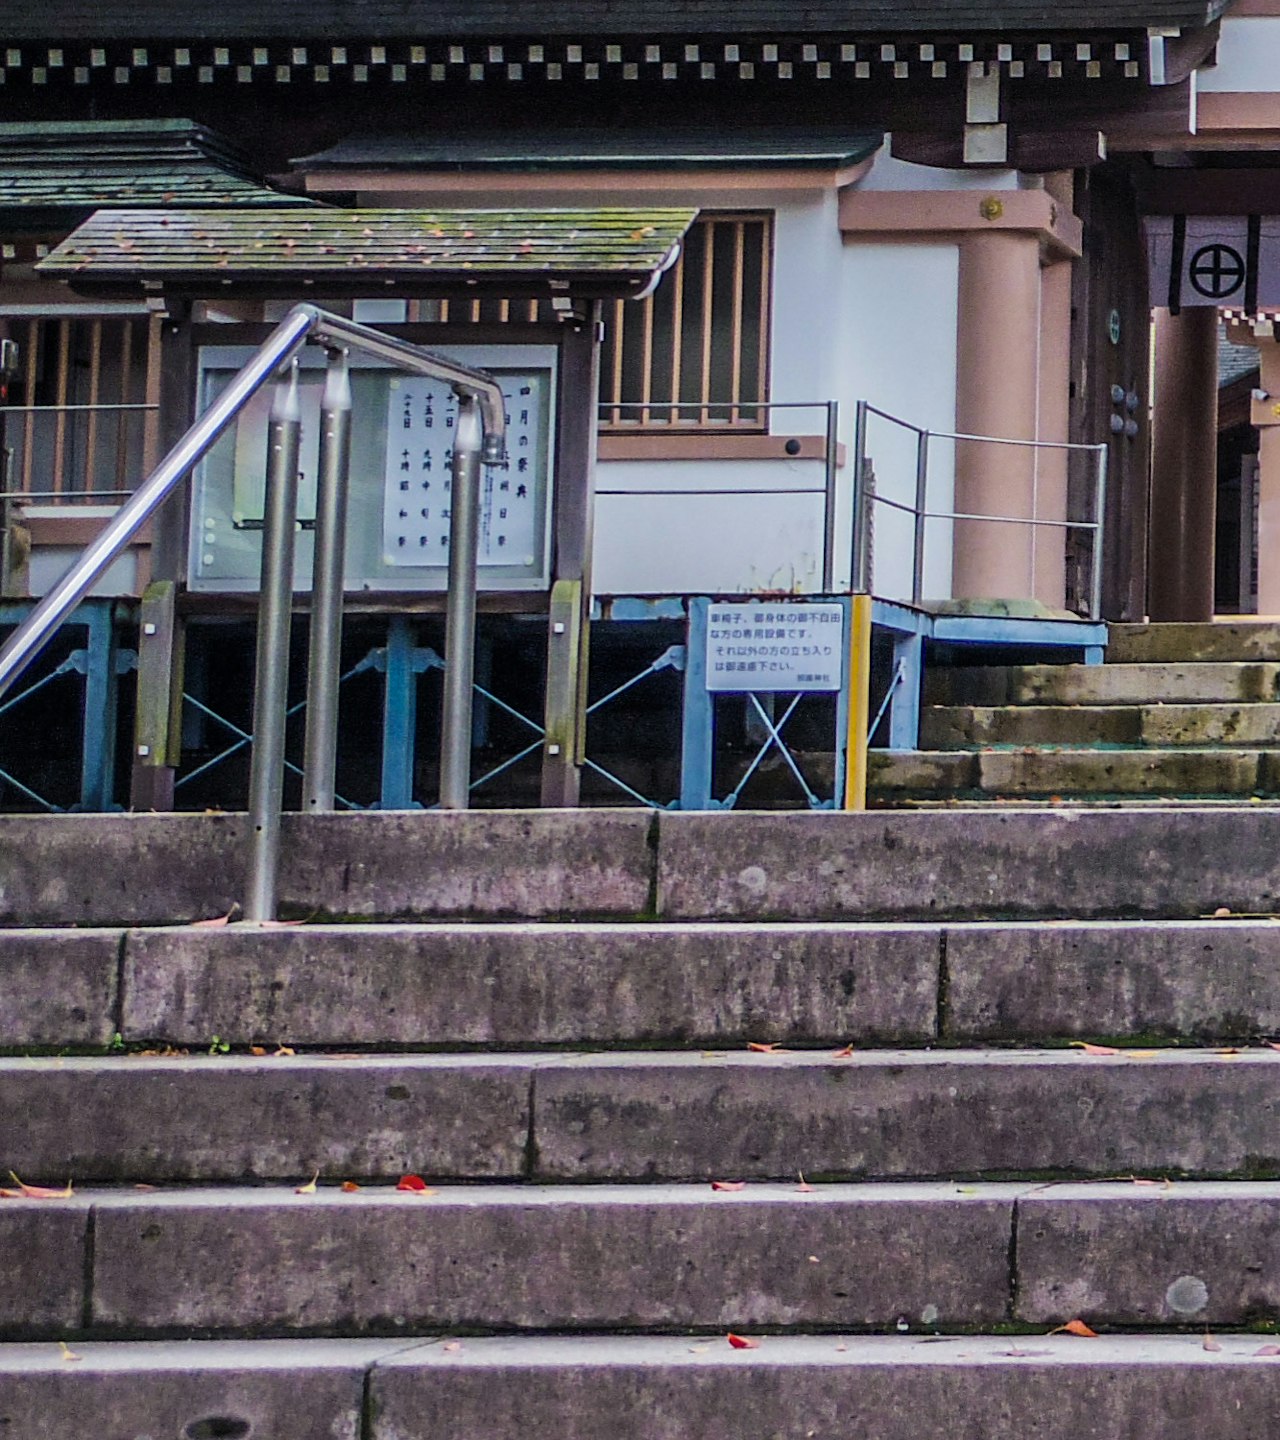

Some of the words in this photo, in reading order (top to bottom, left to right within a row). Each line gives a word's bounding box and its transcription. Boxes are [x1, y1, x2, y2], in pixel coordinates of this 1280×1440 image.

[516, 386, 531, 499] 四月の祭典
[710, 628, 812, 640] な方の専用設備です。
[716, 645, 832, 657] それ以外の方の立ち入り
[715, 661, 795, 672] は御遠慮下さい。
